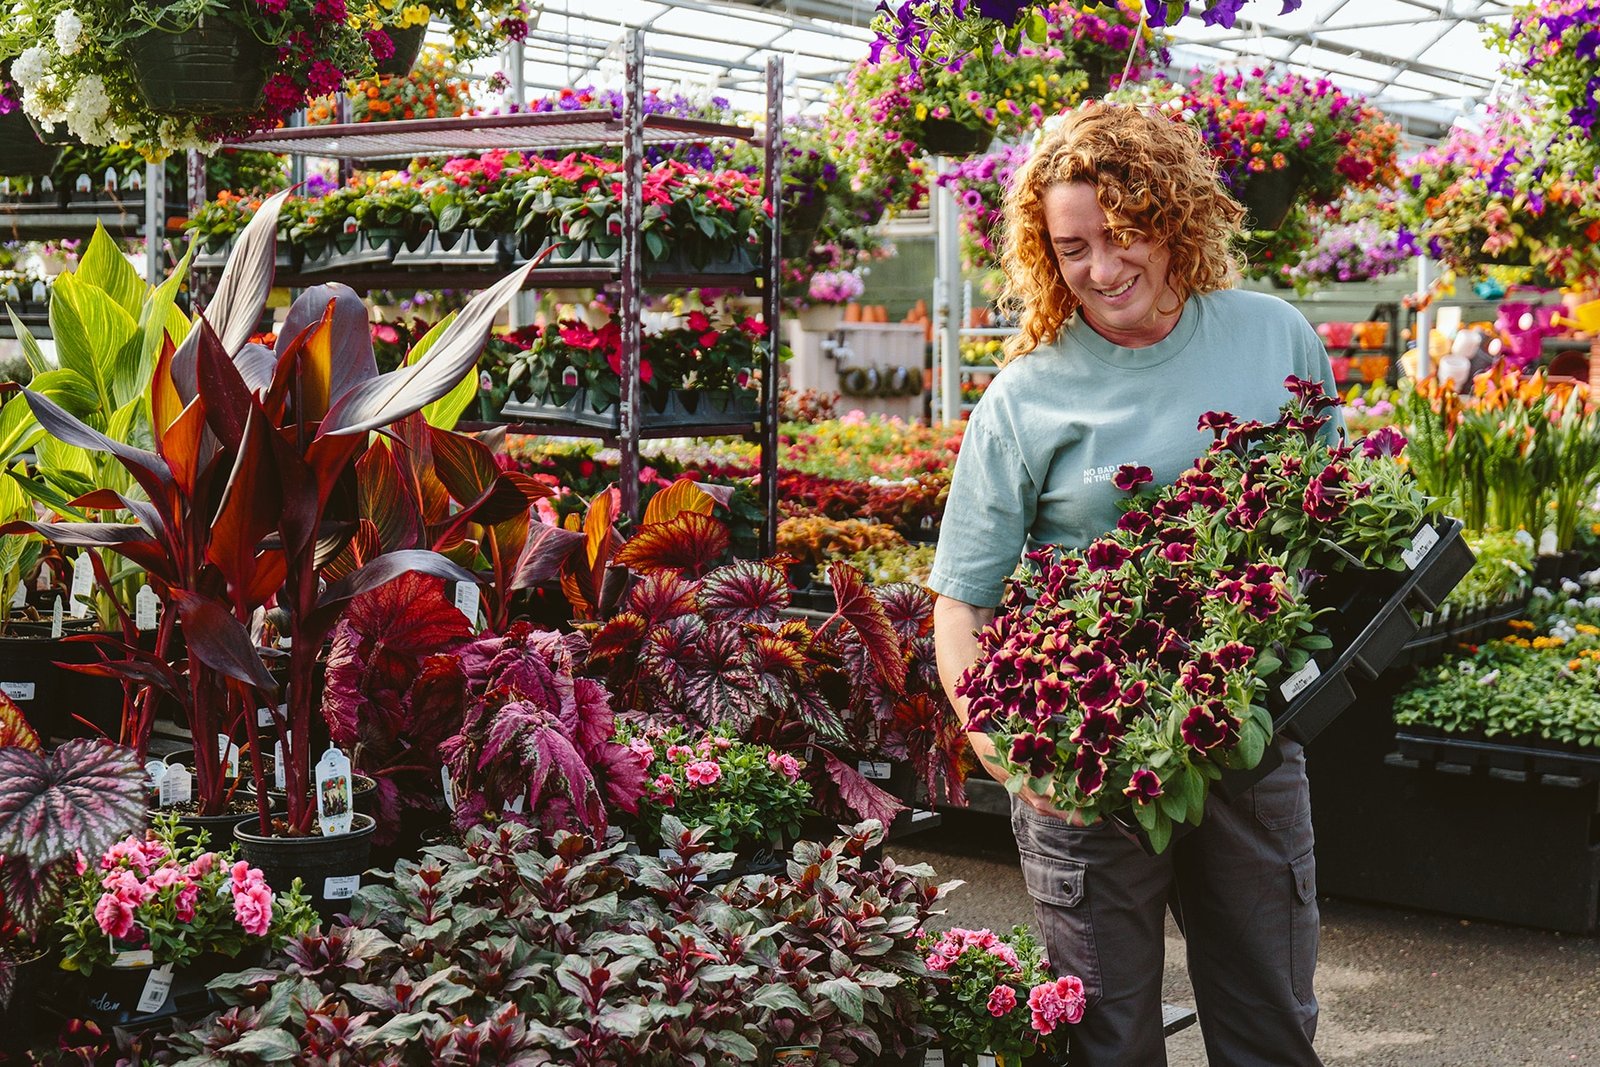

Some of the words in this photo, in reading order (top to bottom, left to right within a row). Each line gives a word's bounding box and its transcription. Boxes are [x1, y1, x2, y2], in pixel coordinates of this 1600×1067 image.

[1083, 468, 1095, 477] NO
[1097, 465, 1115, 474] BAD
[1083, 476, 1092, 485] IN
[1094, 474, 1111, 482] THE
